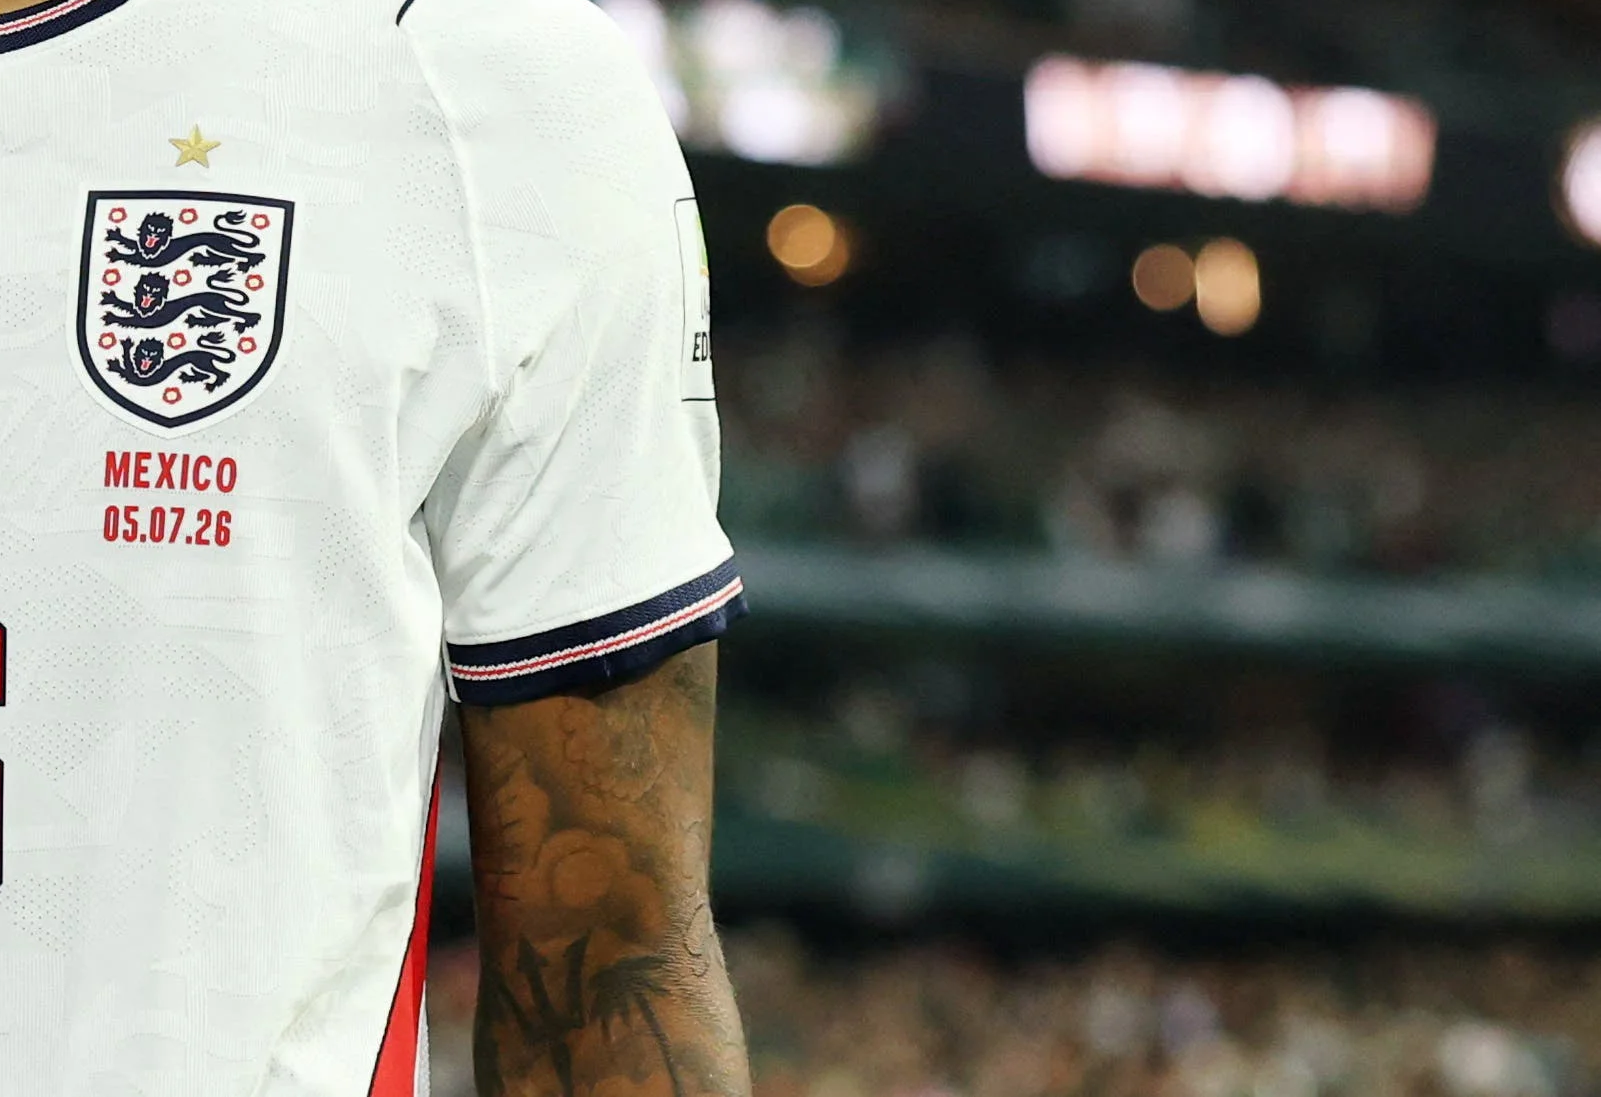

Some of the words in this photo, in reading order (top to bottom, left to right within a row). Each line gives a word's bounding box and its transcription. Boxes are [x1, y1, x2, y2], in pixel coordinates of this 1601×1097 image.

[692, 331, 712, 362] ED
[104, 451, 237, 493] MEXICO
[103, 505, 232, 547] 05.07.26
